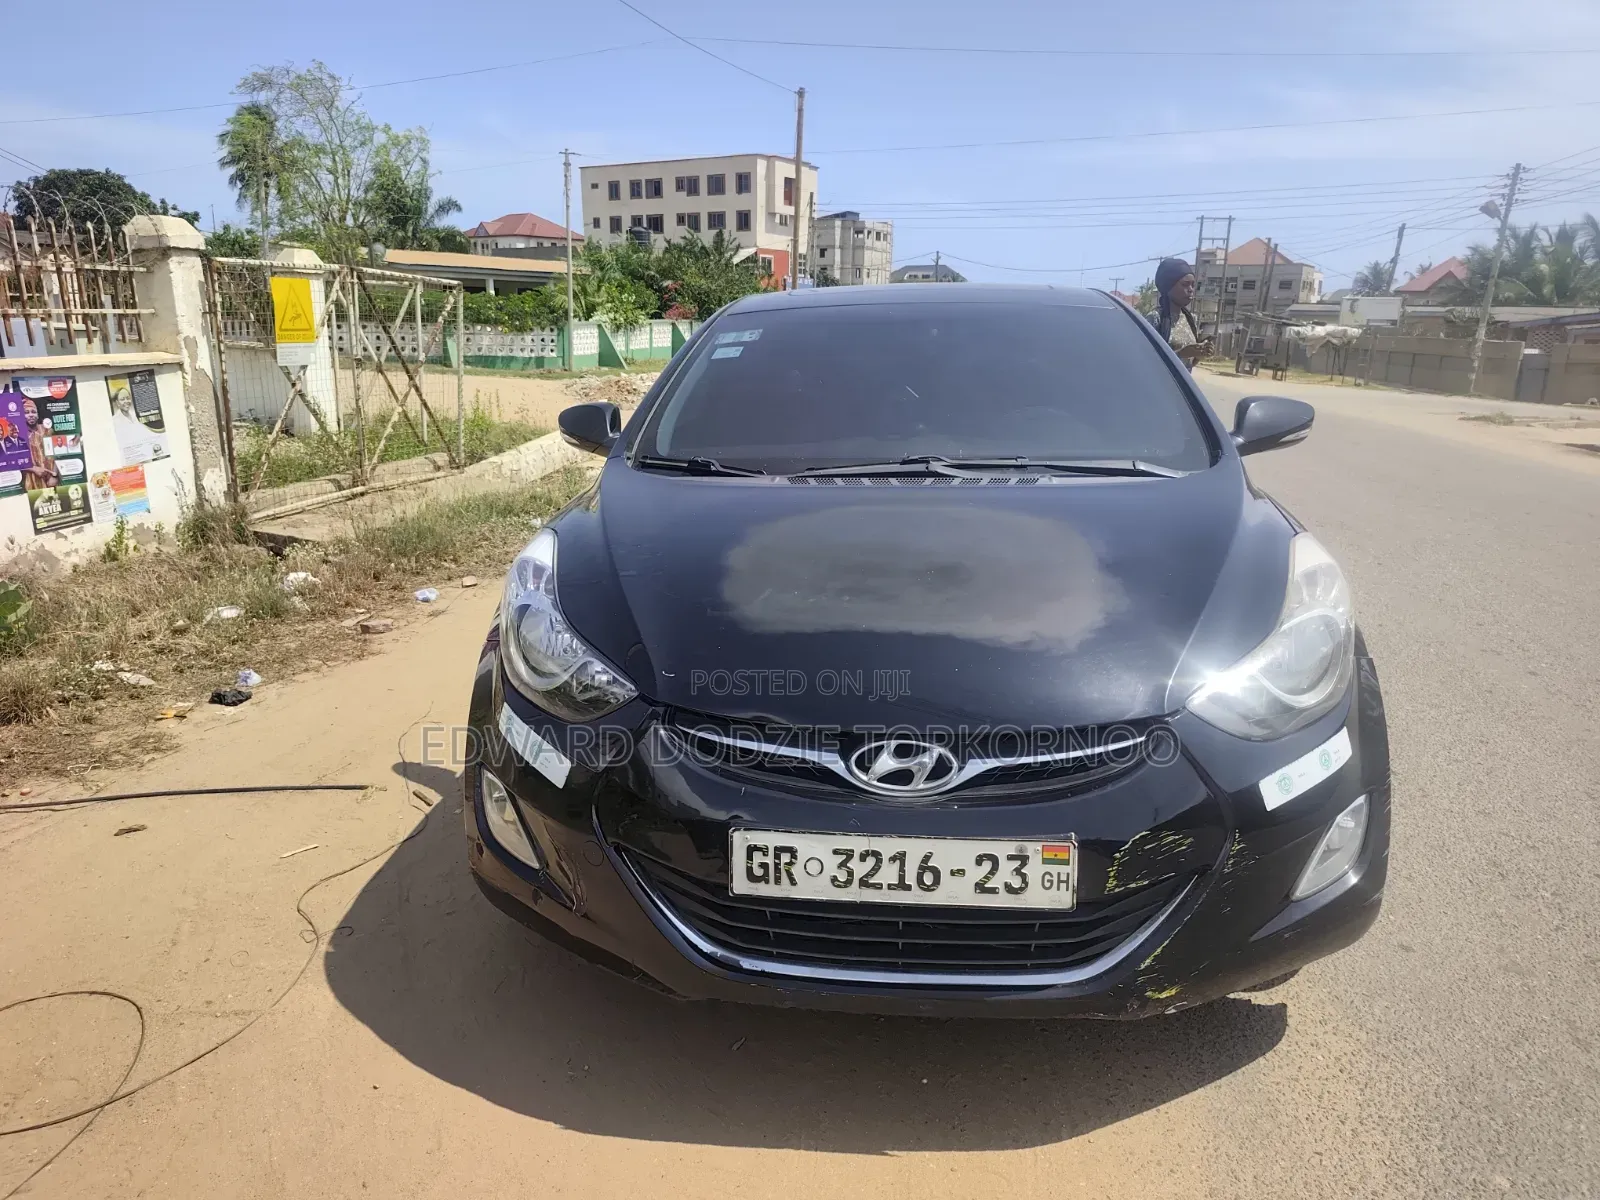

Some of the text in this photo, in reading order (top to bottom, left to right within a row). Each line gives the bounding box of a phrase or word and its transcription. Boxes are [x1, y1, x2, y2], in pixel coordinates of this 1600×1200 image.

[52, 413, 76, 423] VOTE FOR
[745, 844, 798, 886] GR
[1041, 870, 1070, 892] GH
